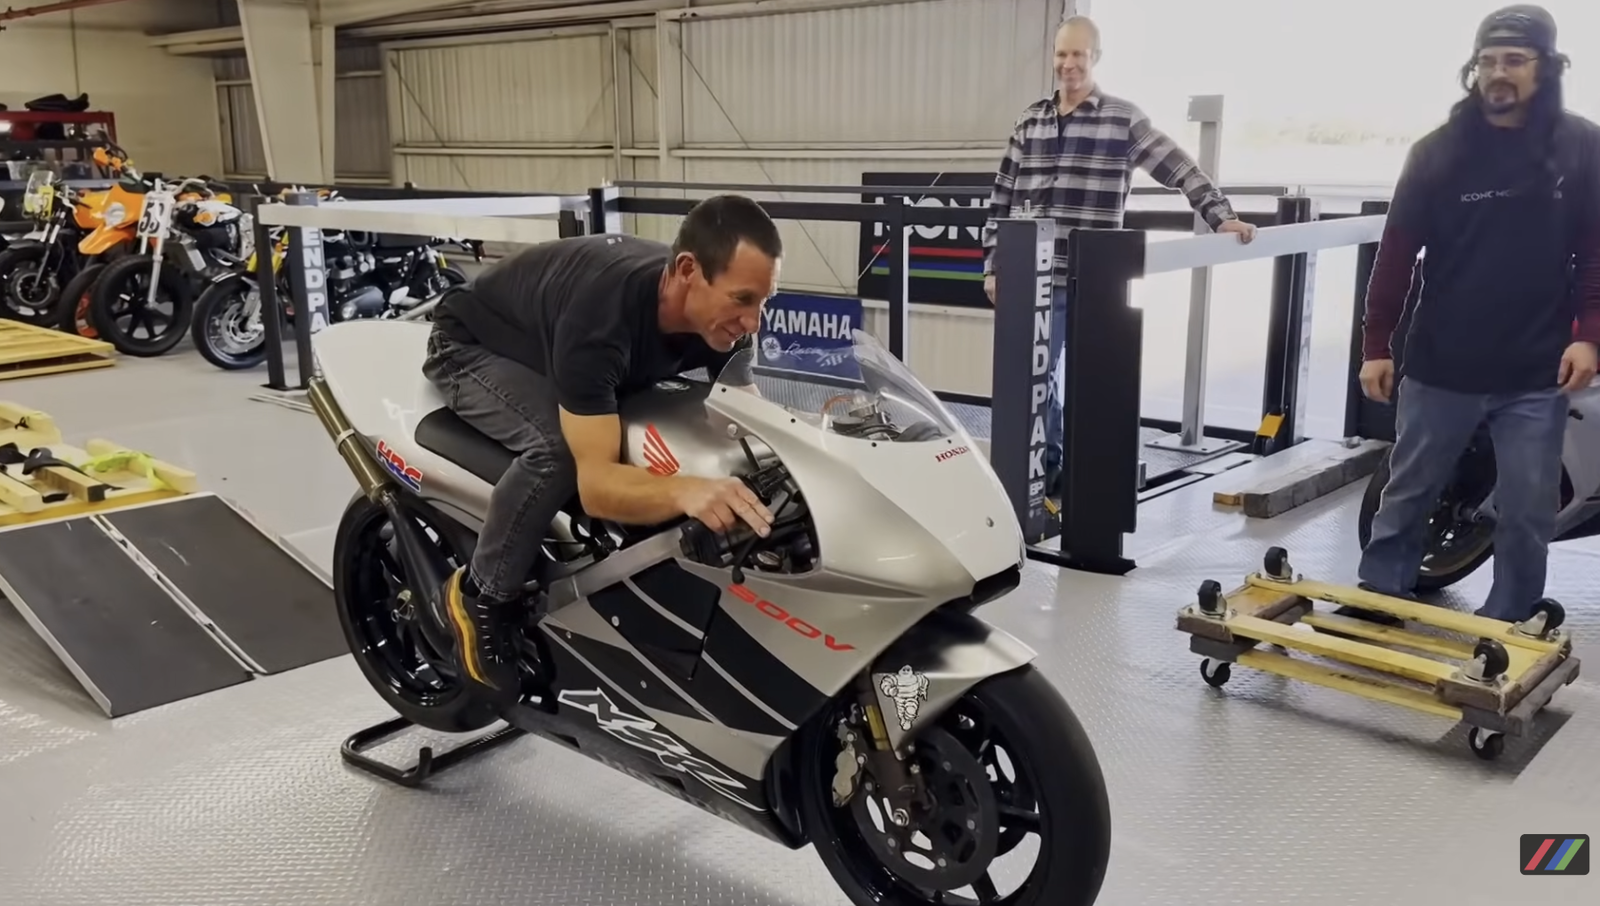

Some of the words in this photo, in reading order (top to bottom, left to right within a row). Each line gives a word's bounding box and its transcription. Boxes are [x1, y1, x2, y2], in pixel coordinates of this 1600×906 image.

[763, 307, 852, 340] YAMAHA
[376, 439, 423, 492] HRC
[727, 584, 855, 651] 500V
